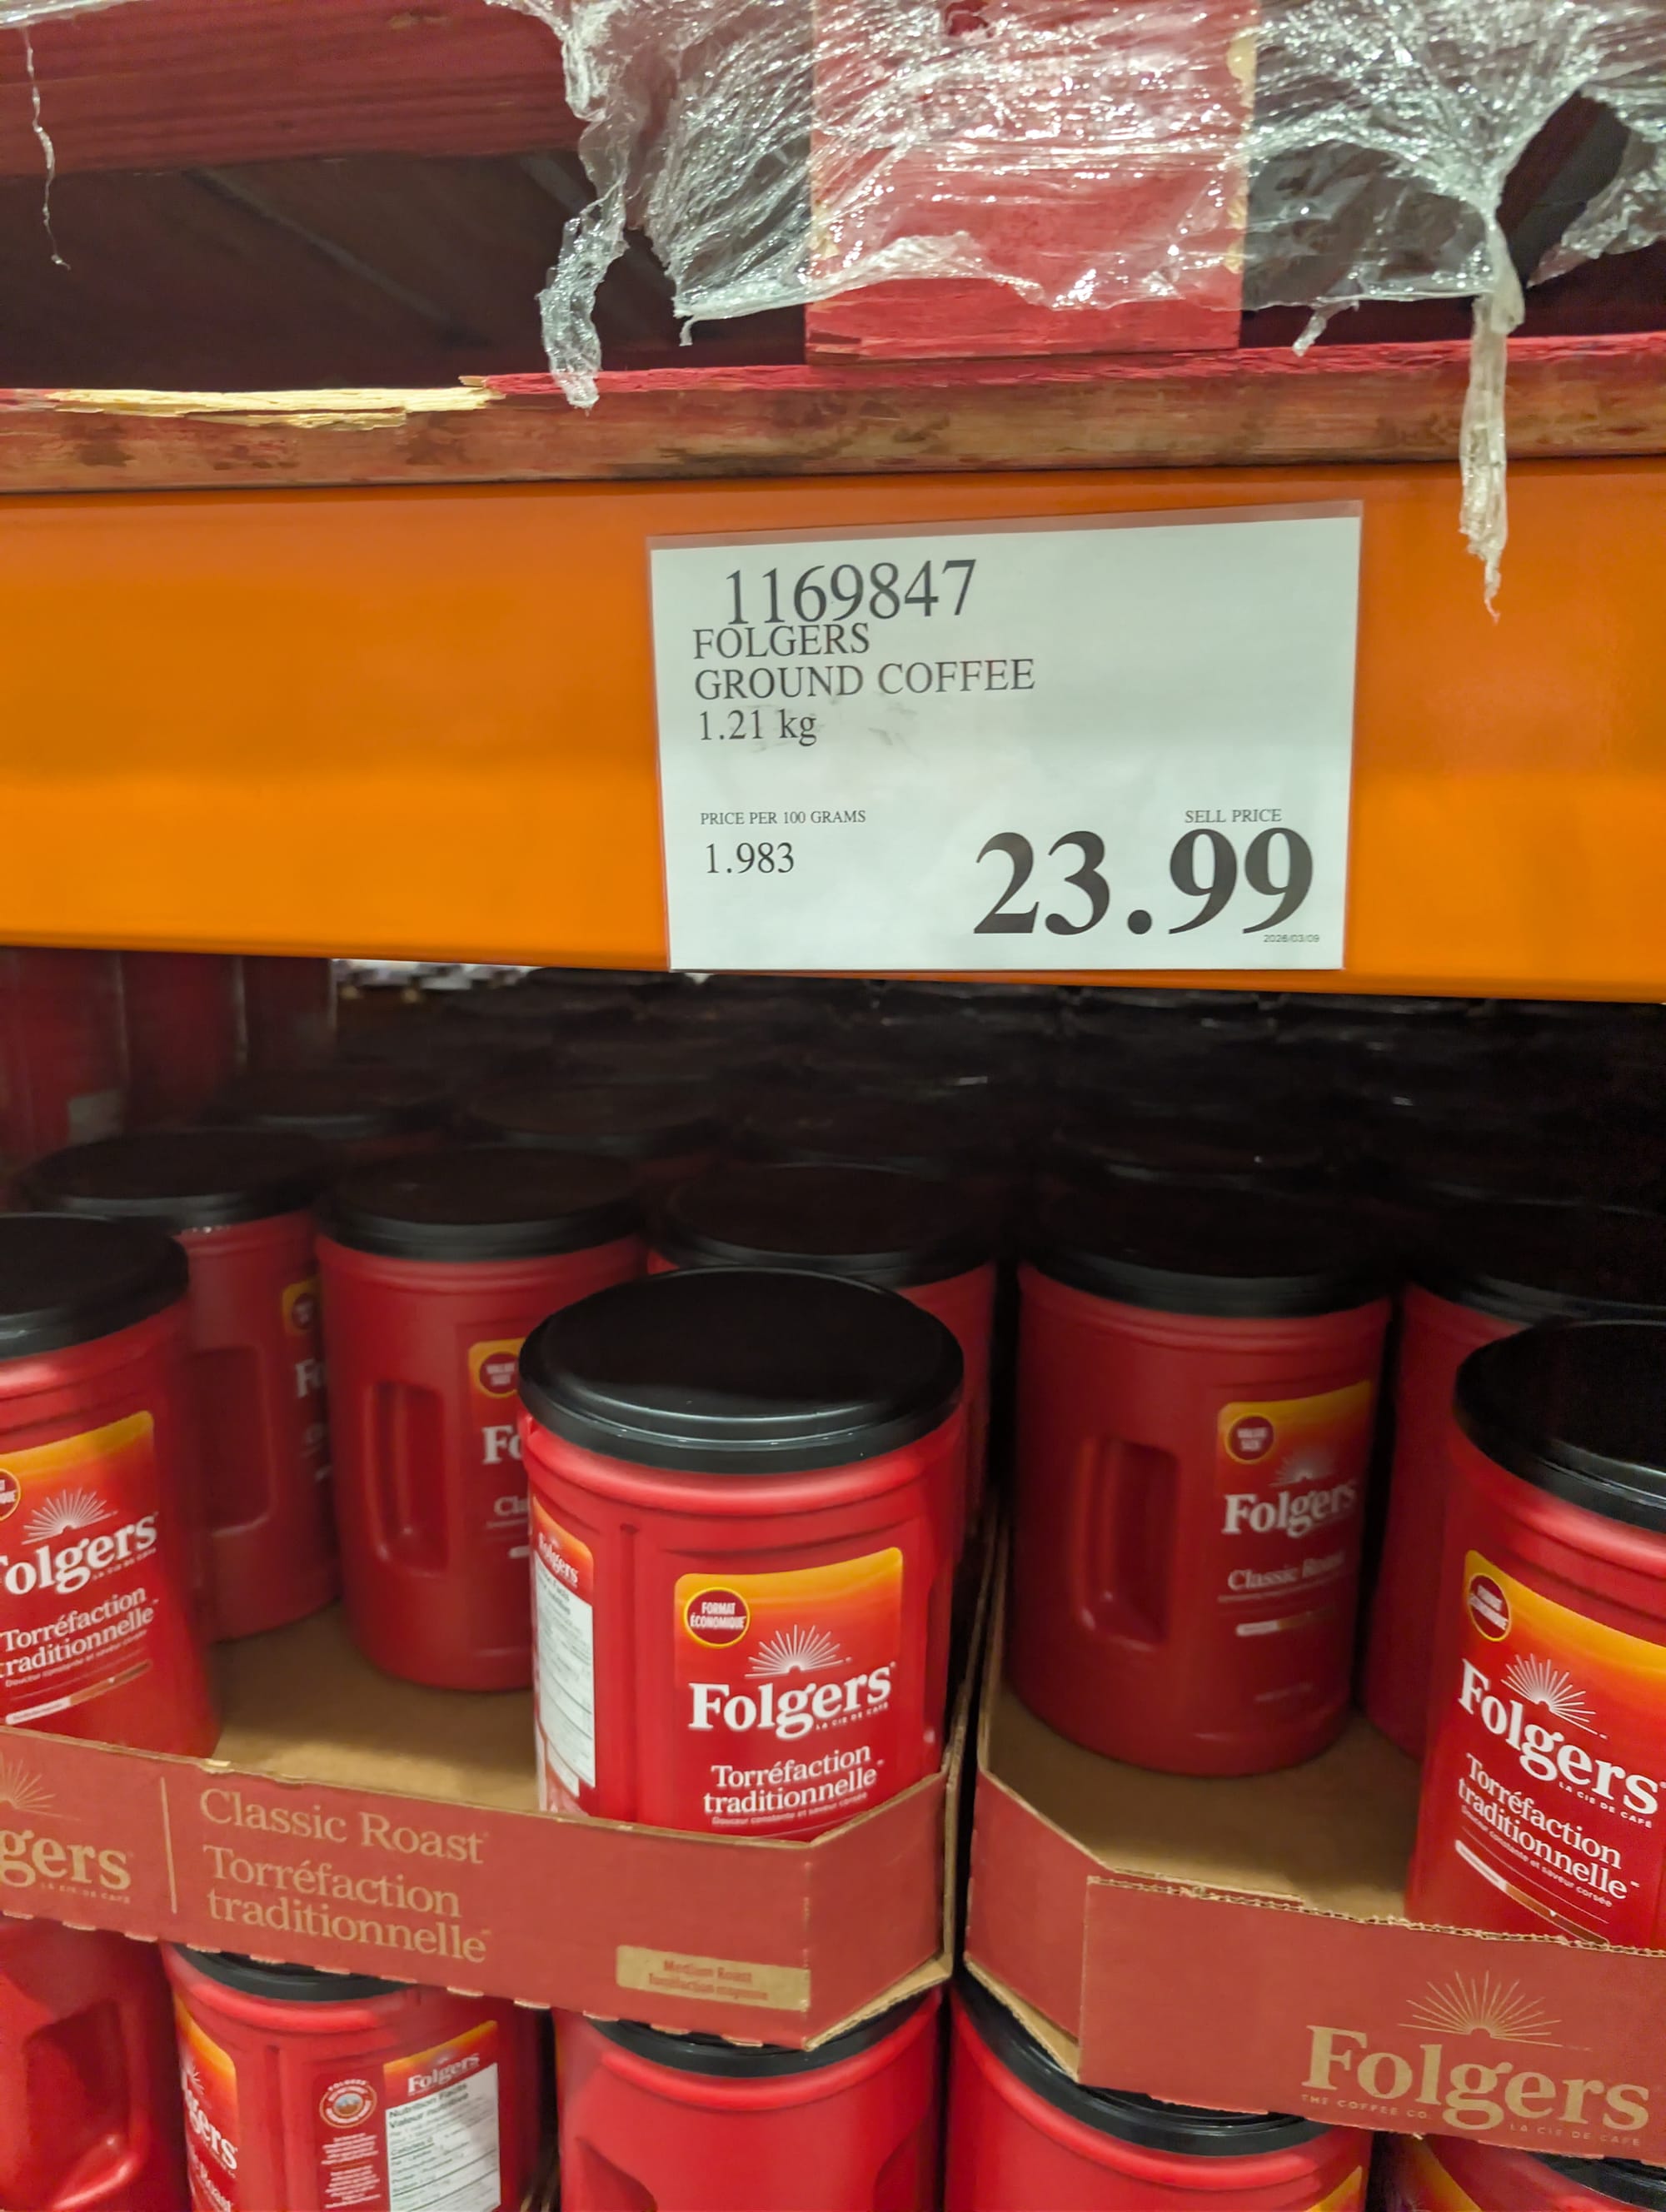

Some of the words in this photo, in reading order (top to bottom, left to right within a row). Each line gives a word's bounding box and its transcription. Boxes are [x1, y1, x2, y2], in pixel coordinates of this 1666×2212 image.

[727, 557, 977, 626] 1169847
[693, 622, 870, 660] FOLGERS
[695, 665, 864, 701] GROUND
[877, 658, 1035, 695] COFFEE
[699, 710, 763, 741] 1.21
[779, 708, 818, 747] kg
[701, 812, 745, 825] PRICE
[749, 811, 778, 825] PER
[783, 811, 806, 824] 100
[811, 810, 866, 824] GRAMS
[1185, 810, 1227, 825] SELL
[1232, 809, 1283, 825] PRICE
[706, 841, 795, 874] 1.983
[973, 827, 1314, 937] 23.99
[1221, 1485, 1357, 1538] Folgers
[0, 1515, 157, 1595] olgers
[1228, 1563, 1299, 1592] Classic
[0, 1587, 147, 1652] Torréfaction
[701, 1602, 736, 1615] FORMAT
[688, 1666, 891, 1740] Folgers
[1457, 1657, 1659, 1815] Folgers
[703, 1766, 878, 1815] traditionnelle
[711, 1744, 871, 1789] Torréfaction
[1466, 1751, 1622, 1870] Torréfaction
[1559, 1781, 1573, 1793] LA
[1577, 1791, 1596, 1805] CIE
[1599, 1801, 1616, 1814] DE
[200, 1787, 348, 1844] Classic
[358, 1811, 484, 1865] Roast
[1458, 1777, 1628, 1900] traditionnelle
[202, 1844, 463, 1918] Torréfaction
[207, 1886, 487, 1964] traditionnelle
[407, 2052, 481, 2096] Folgers
[1300, 2025, 1650, 2133] Folgers
[1300, 2094, 1329, 2105] THE
[1336, 2100, 1400, 2116] COFFEE
[1509, 2123, 1529, 2133] LA
[1571, 2130, 1592, 2140] DE
